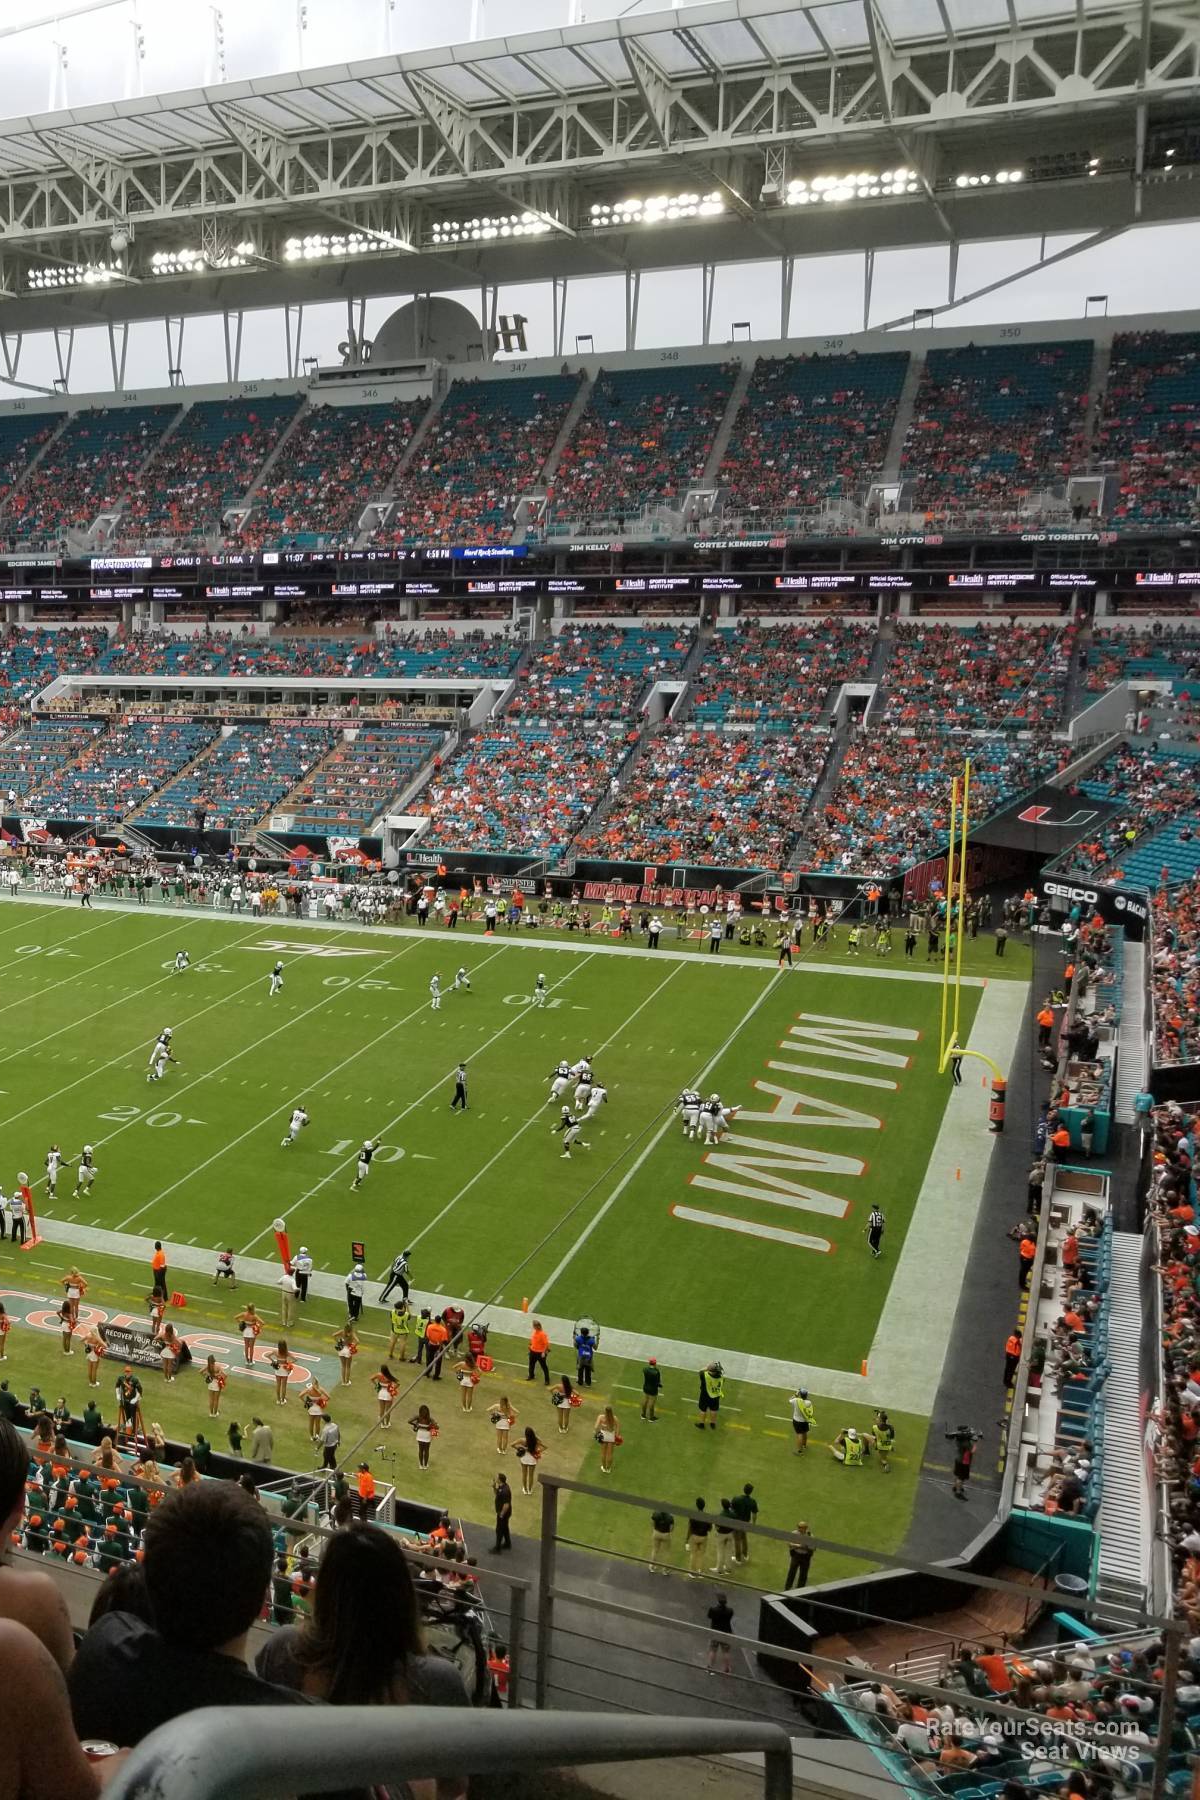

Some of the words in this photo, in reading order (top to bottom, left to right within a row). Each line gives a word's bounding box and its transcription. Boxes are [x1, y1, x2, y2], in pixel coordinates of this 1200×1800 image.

[1000, 328, 1021, 338] 350
[823, 340, 843, 350] 349
[660, 352, 679, 361] 348
[510, 363, 527, 373] 347
[243, 385, 258, 393] 345
[122, 394, 137, 402] 344
[362, 390, 378, 398] 346
[881, 537, 897, 546] JIM
[899, 536, 924, 545] OTTO
[1048, 533, 1099, 541] TORRETTA
[570, 544, 584, 552] JIM
[585, 543, 610, 551] KELLY
[694, 541, 727, 549] CORTEZ
[729, 540, 769, 548] KENNEDY
[229, 556, 243, 564] MIA
[285, 554, 304, 563] 11:07
[367, 552, 376, 560] 13
[176, 557, 193, 566] CMU
[1043, 882, 1098, 904] GEICO
[97, 1105, 183, 1127] 20
[668, 1010, 924, 1254] MIAMI
[319, 1138, 407, 1164] 10
[353, 1243, 363, 1256] 3
[172, 1293, 182, 1305] 10
[105, 1328, 133, 1342] RECOVER
[133, 1335, 151, 1347] YOUR
